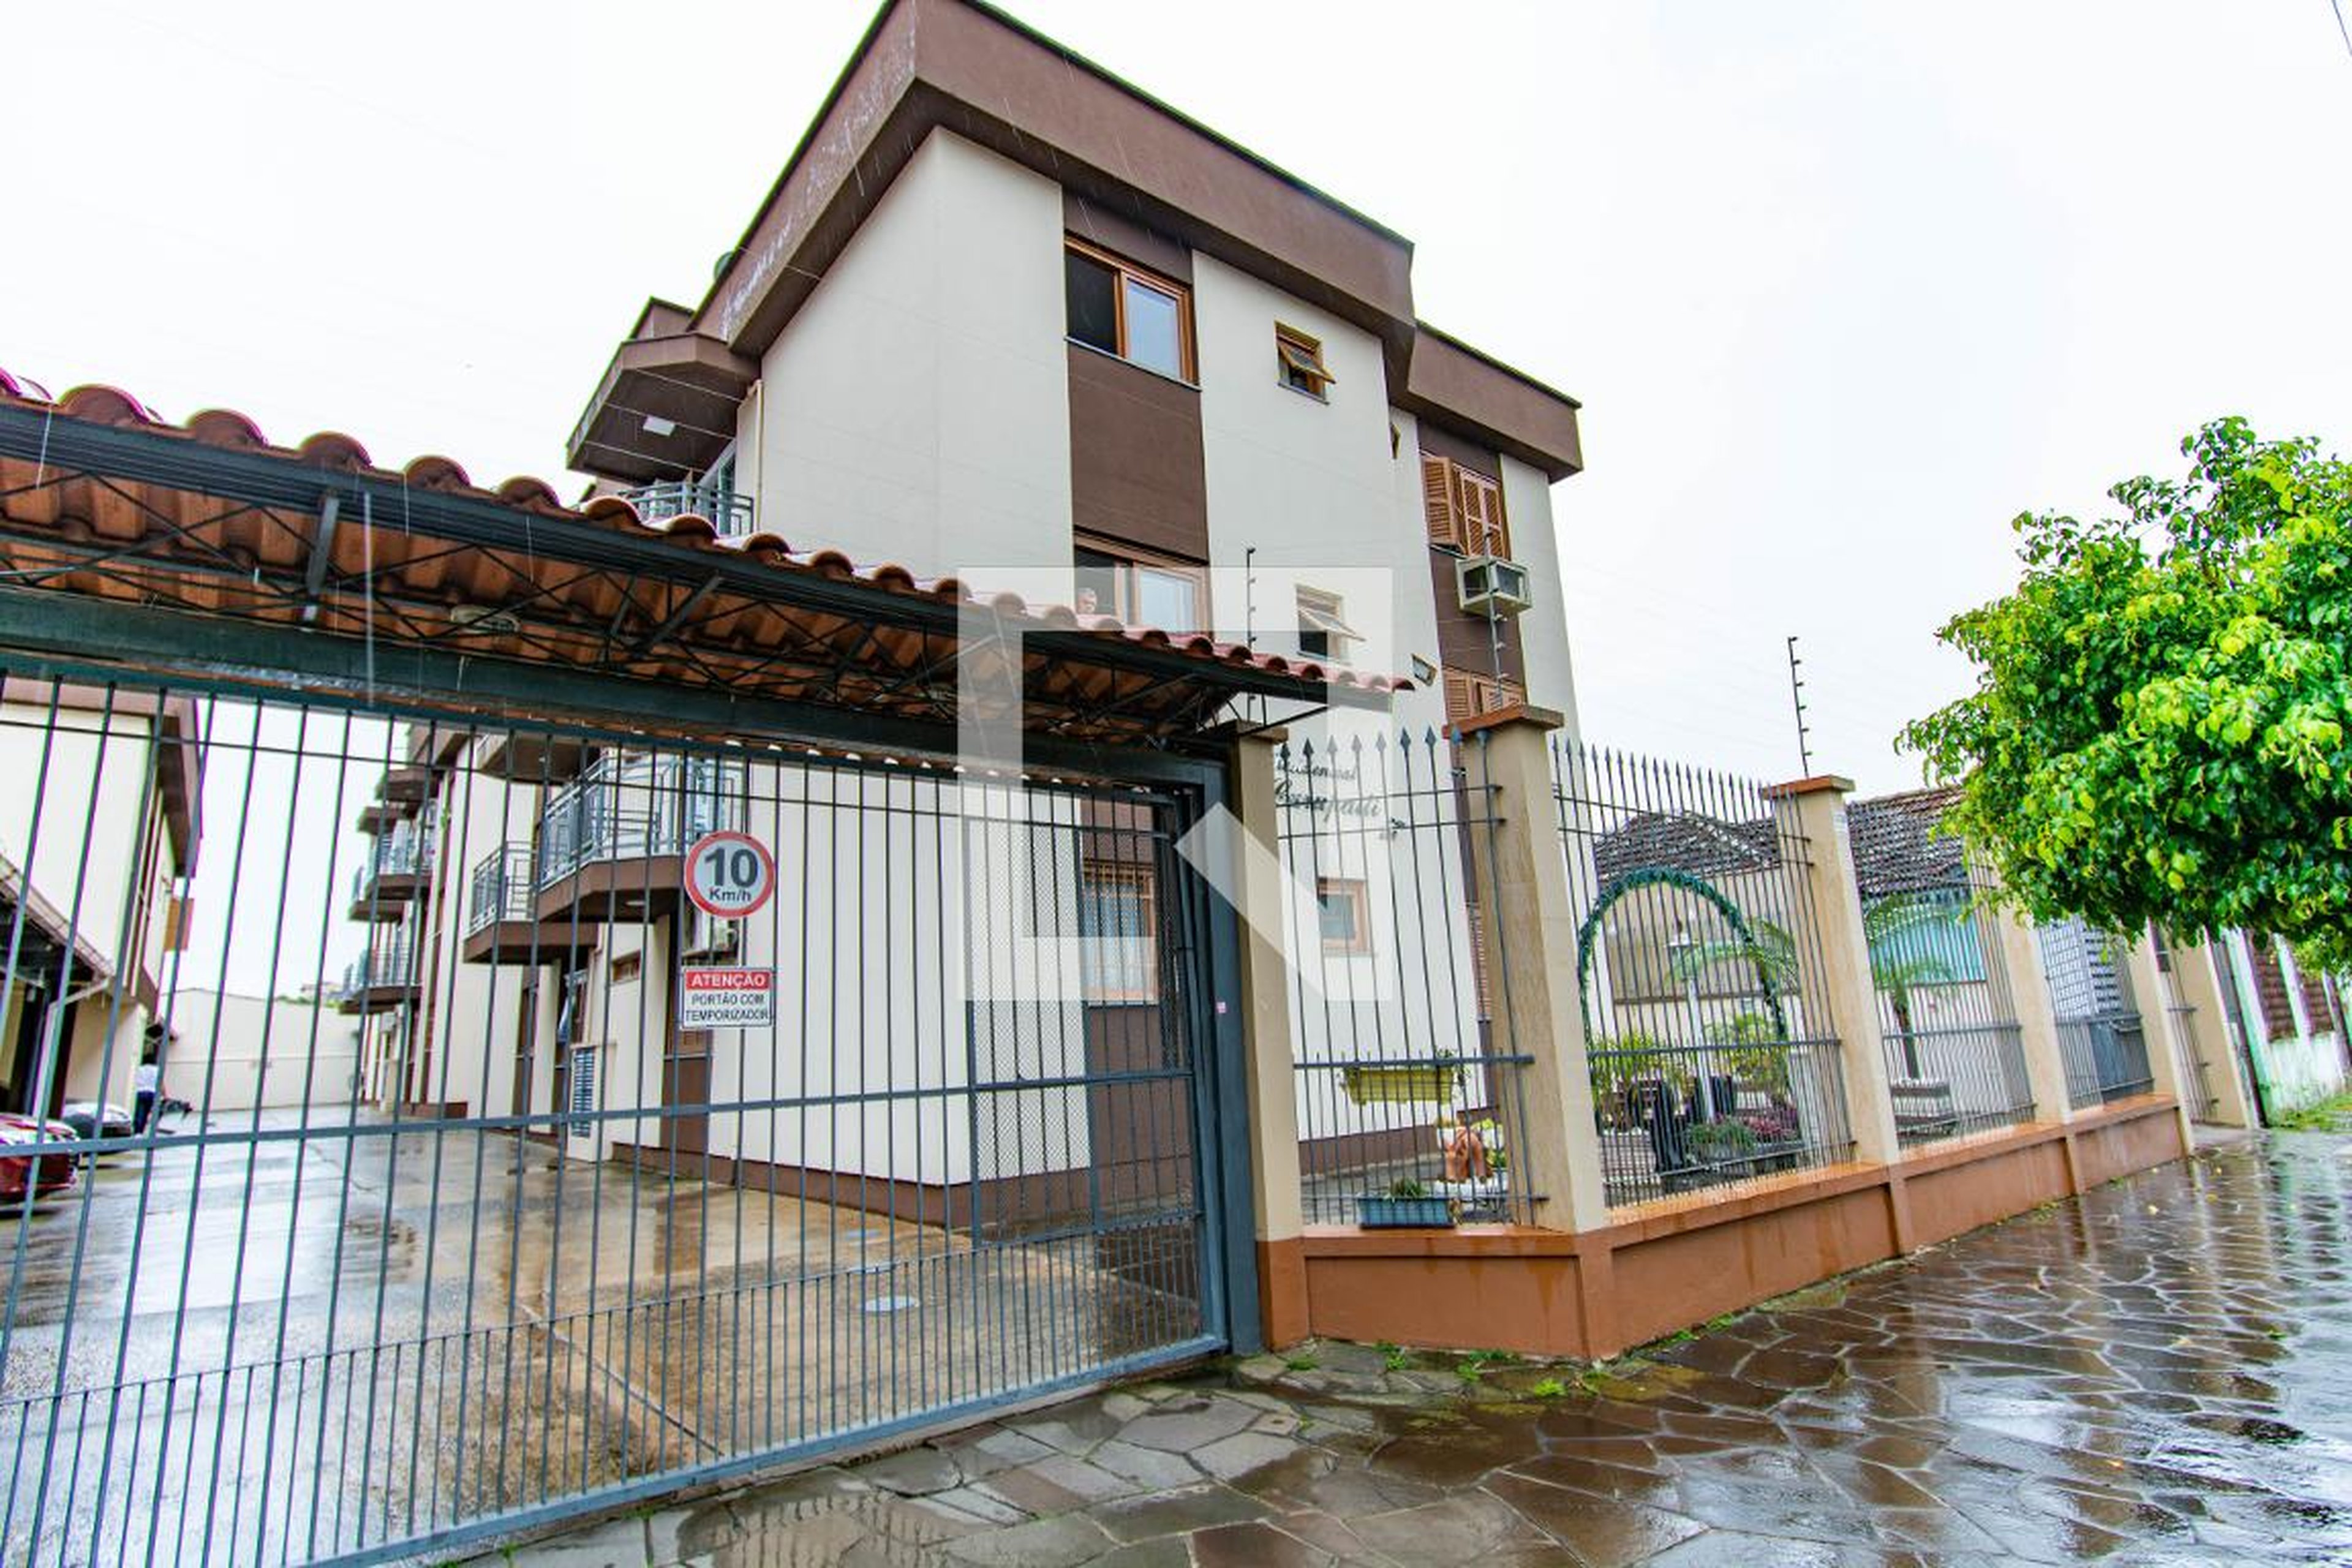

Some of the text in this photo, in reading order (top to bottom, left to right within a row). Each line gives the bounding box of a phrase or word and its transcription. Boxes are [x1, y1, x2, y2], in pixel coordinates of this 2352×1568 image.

[704, 848, 758, 888] 10
[709, 888, 752, 902] Km/h
[691, 972, 766, 989] ATENÇÃO
[692, 992, 765, 1005] PORTÃO COM
[685, 1009, 769, 1022] TEMPORIZADOR
